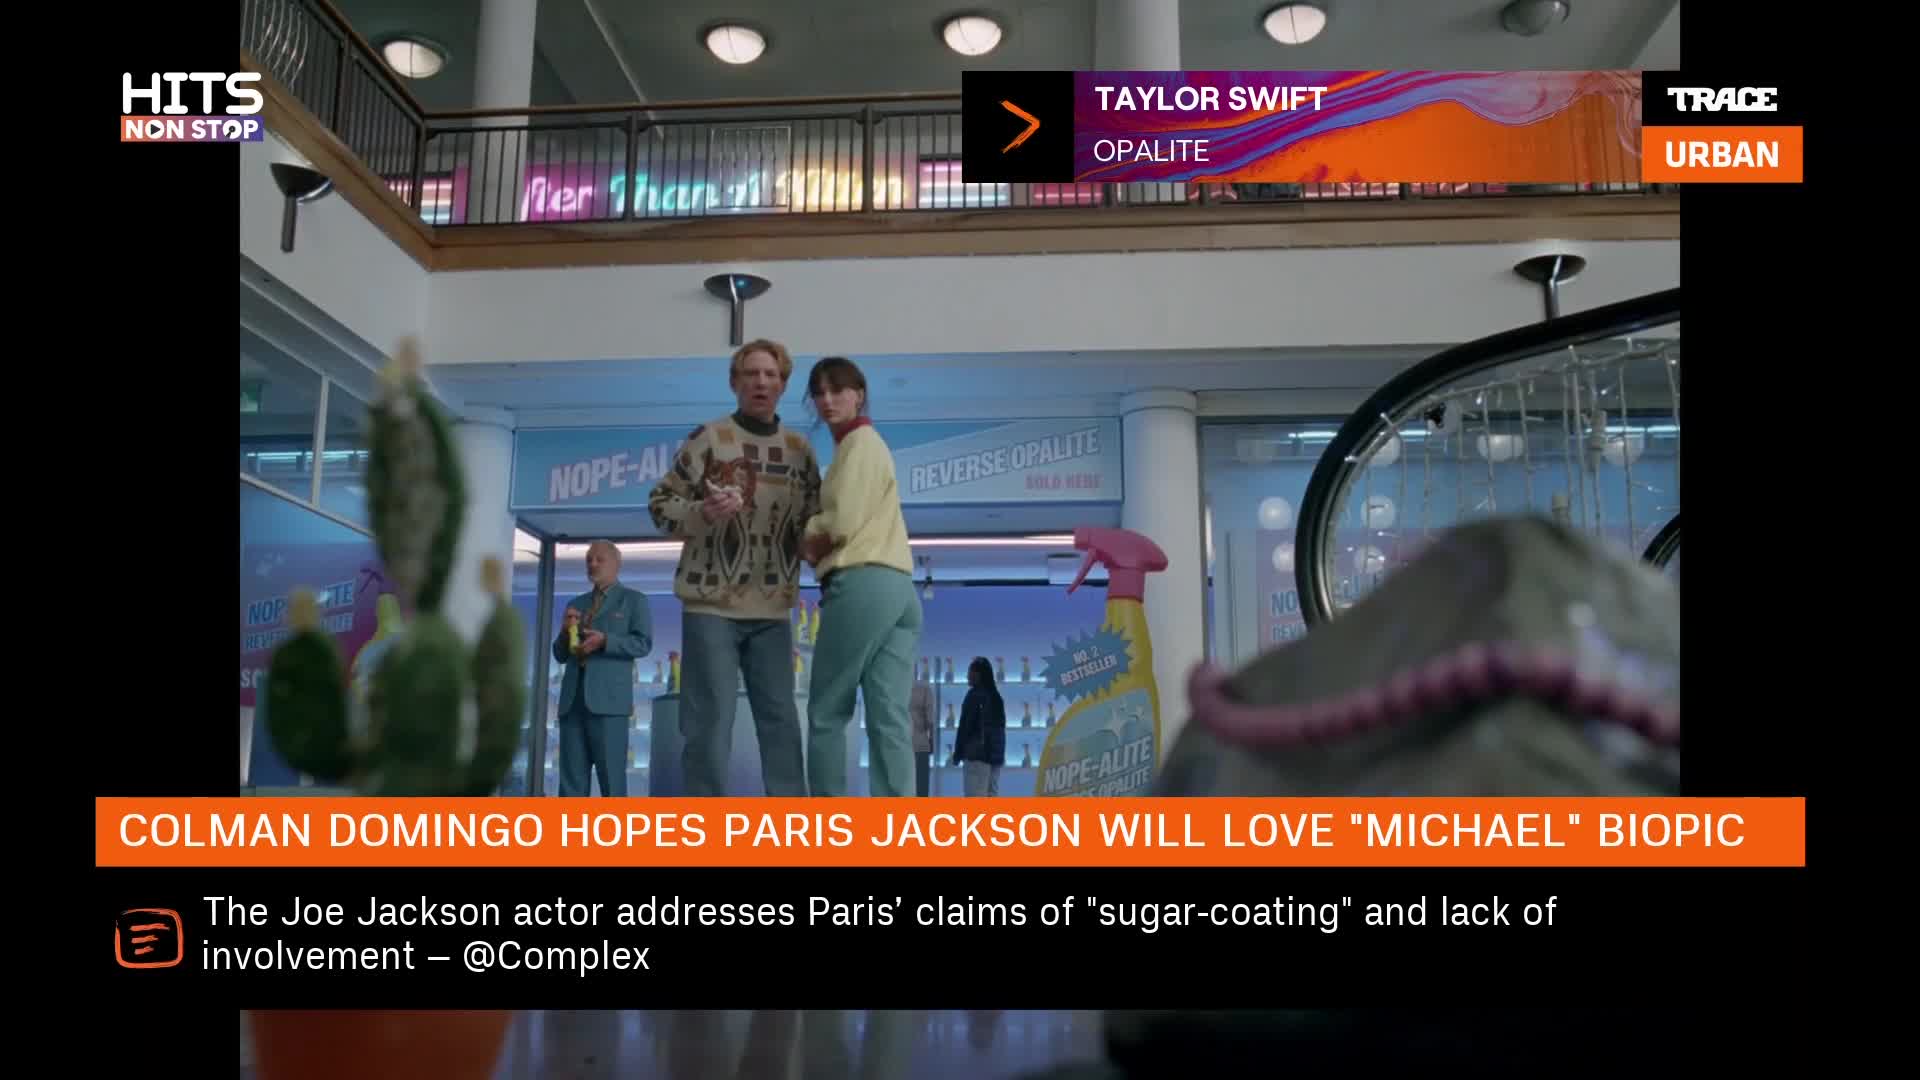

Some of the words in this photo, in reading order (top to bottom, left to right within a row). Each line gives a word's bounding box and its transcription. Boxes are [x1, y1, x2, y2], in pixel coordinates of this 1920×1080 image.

[911, 446, 1006, 492] REVERSE
[1011, 426, 1100, 470] OPALITE
[1060, 654, 1118, 686] BESTSELLER
[1043, 736, 1152, 793] NOPE-ALITE
